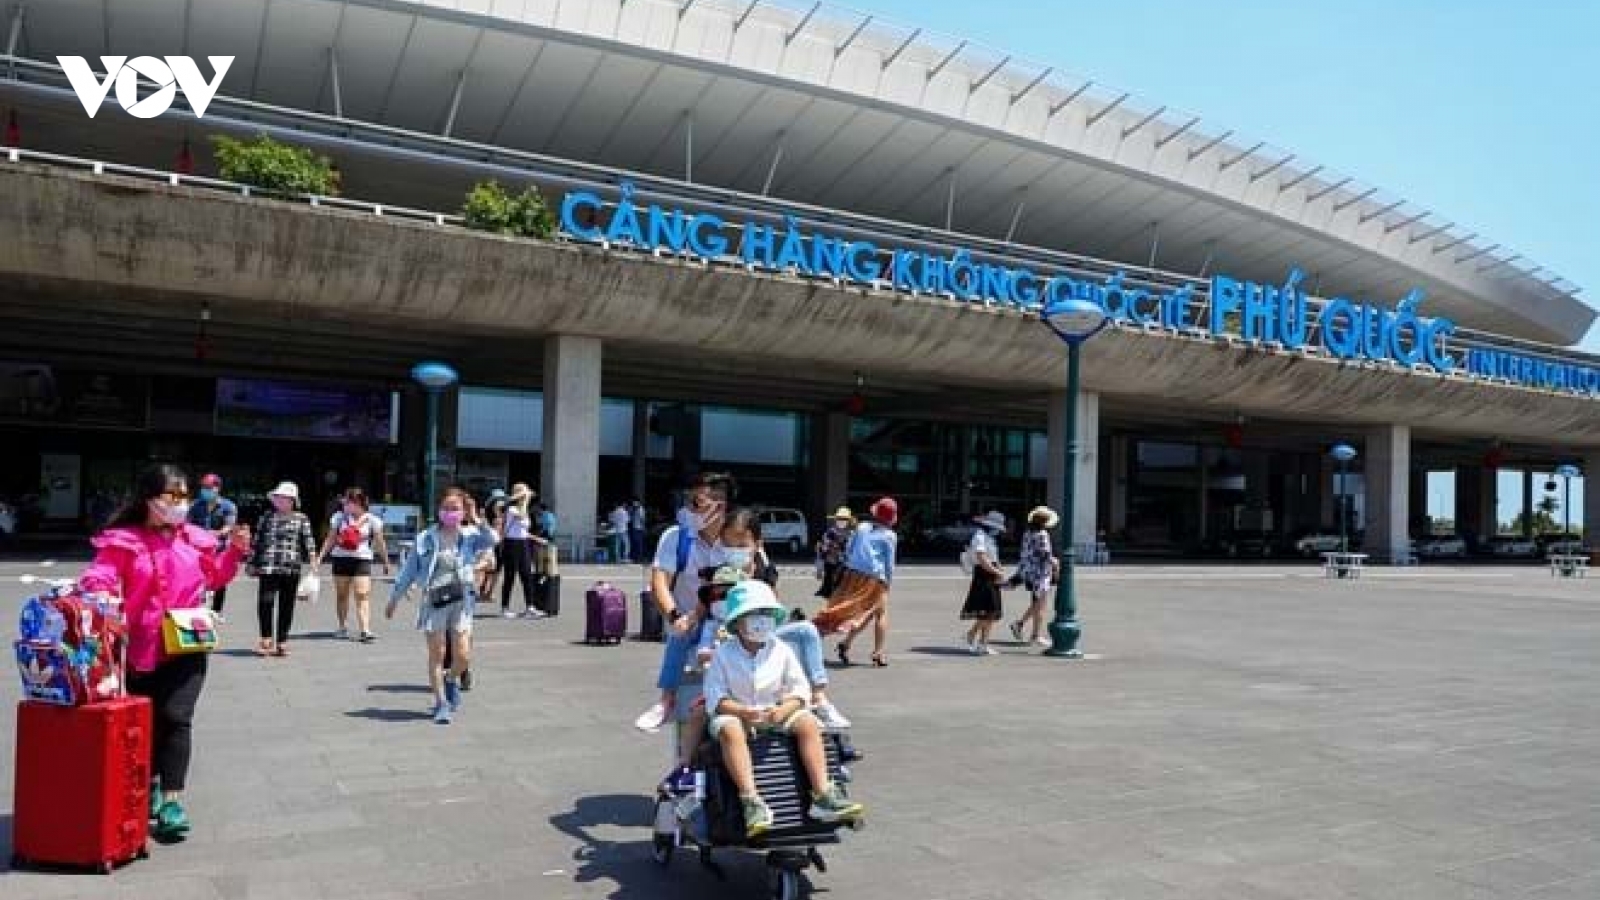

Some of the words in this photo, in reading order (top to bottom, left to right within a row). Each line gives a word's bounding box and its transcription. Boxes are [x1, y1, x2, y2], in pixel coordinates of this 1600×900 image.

[561, 180, 729, 258] CẢNG
[741, 212, 881, 282] HÀNG
[893, 248, 1038, 306] KHÔNG
[1211, 264, 1307, 350] PHÚ
[1321, 287, 1455, 373] QUỐC
